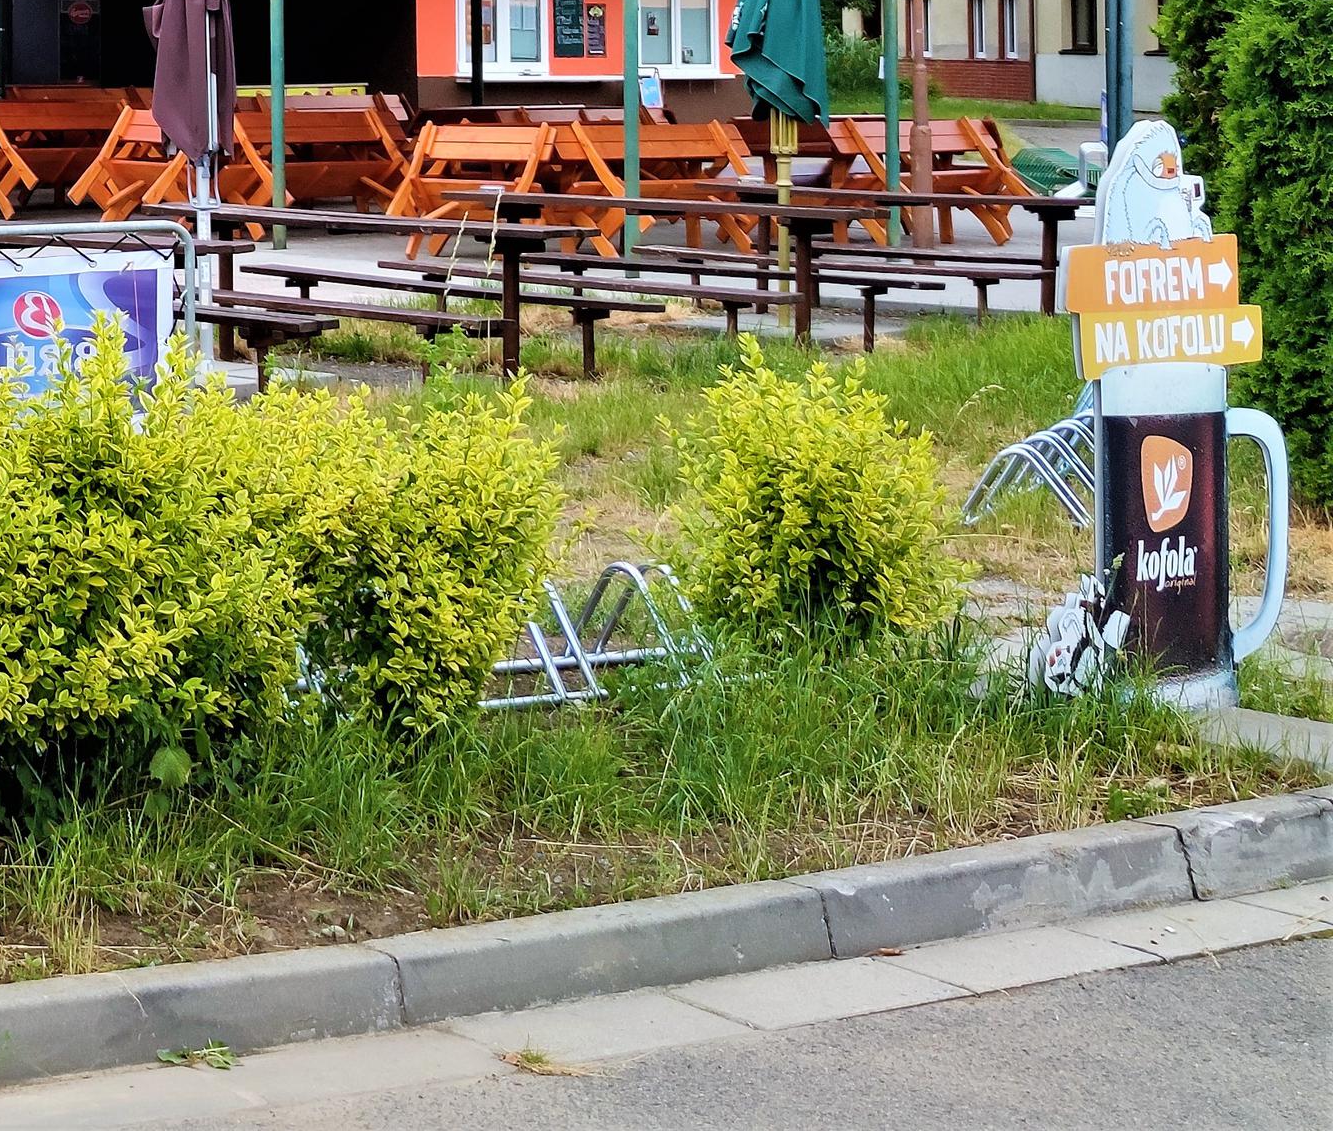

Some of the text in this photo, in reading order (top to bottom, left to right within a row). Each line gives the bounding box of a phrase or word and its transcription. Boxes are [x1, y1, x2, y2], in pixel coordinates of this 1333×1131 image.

[1104, 256, 1205, 305] FOFREM
[1095, 314, 1226, 364] NA KOFOLU
[1136, 535, 1196, 592] kofola
[1163, 571, 1198, 595] original
